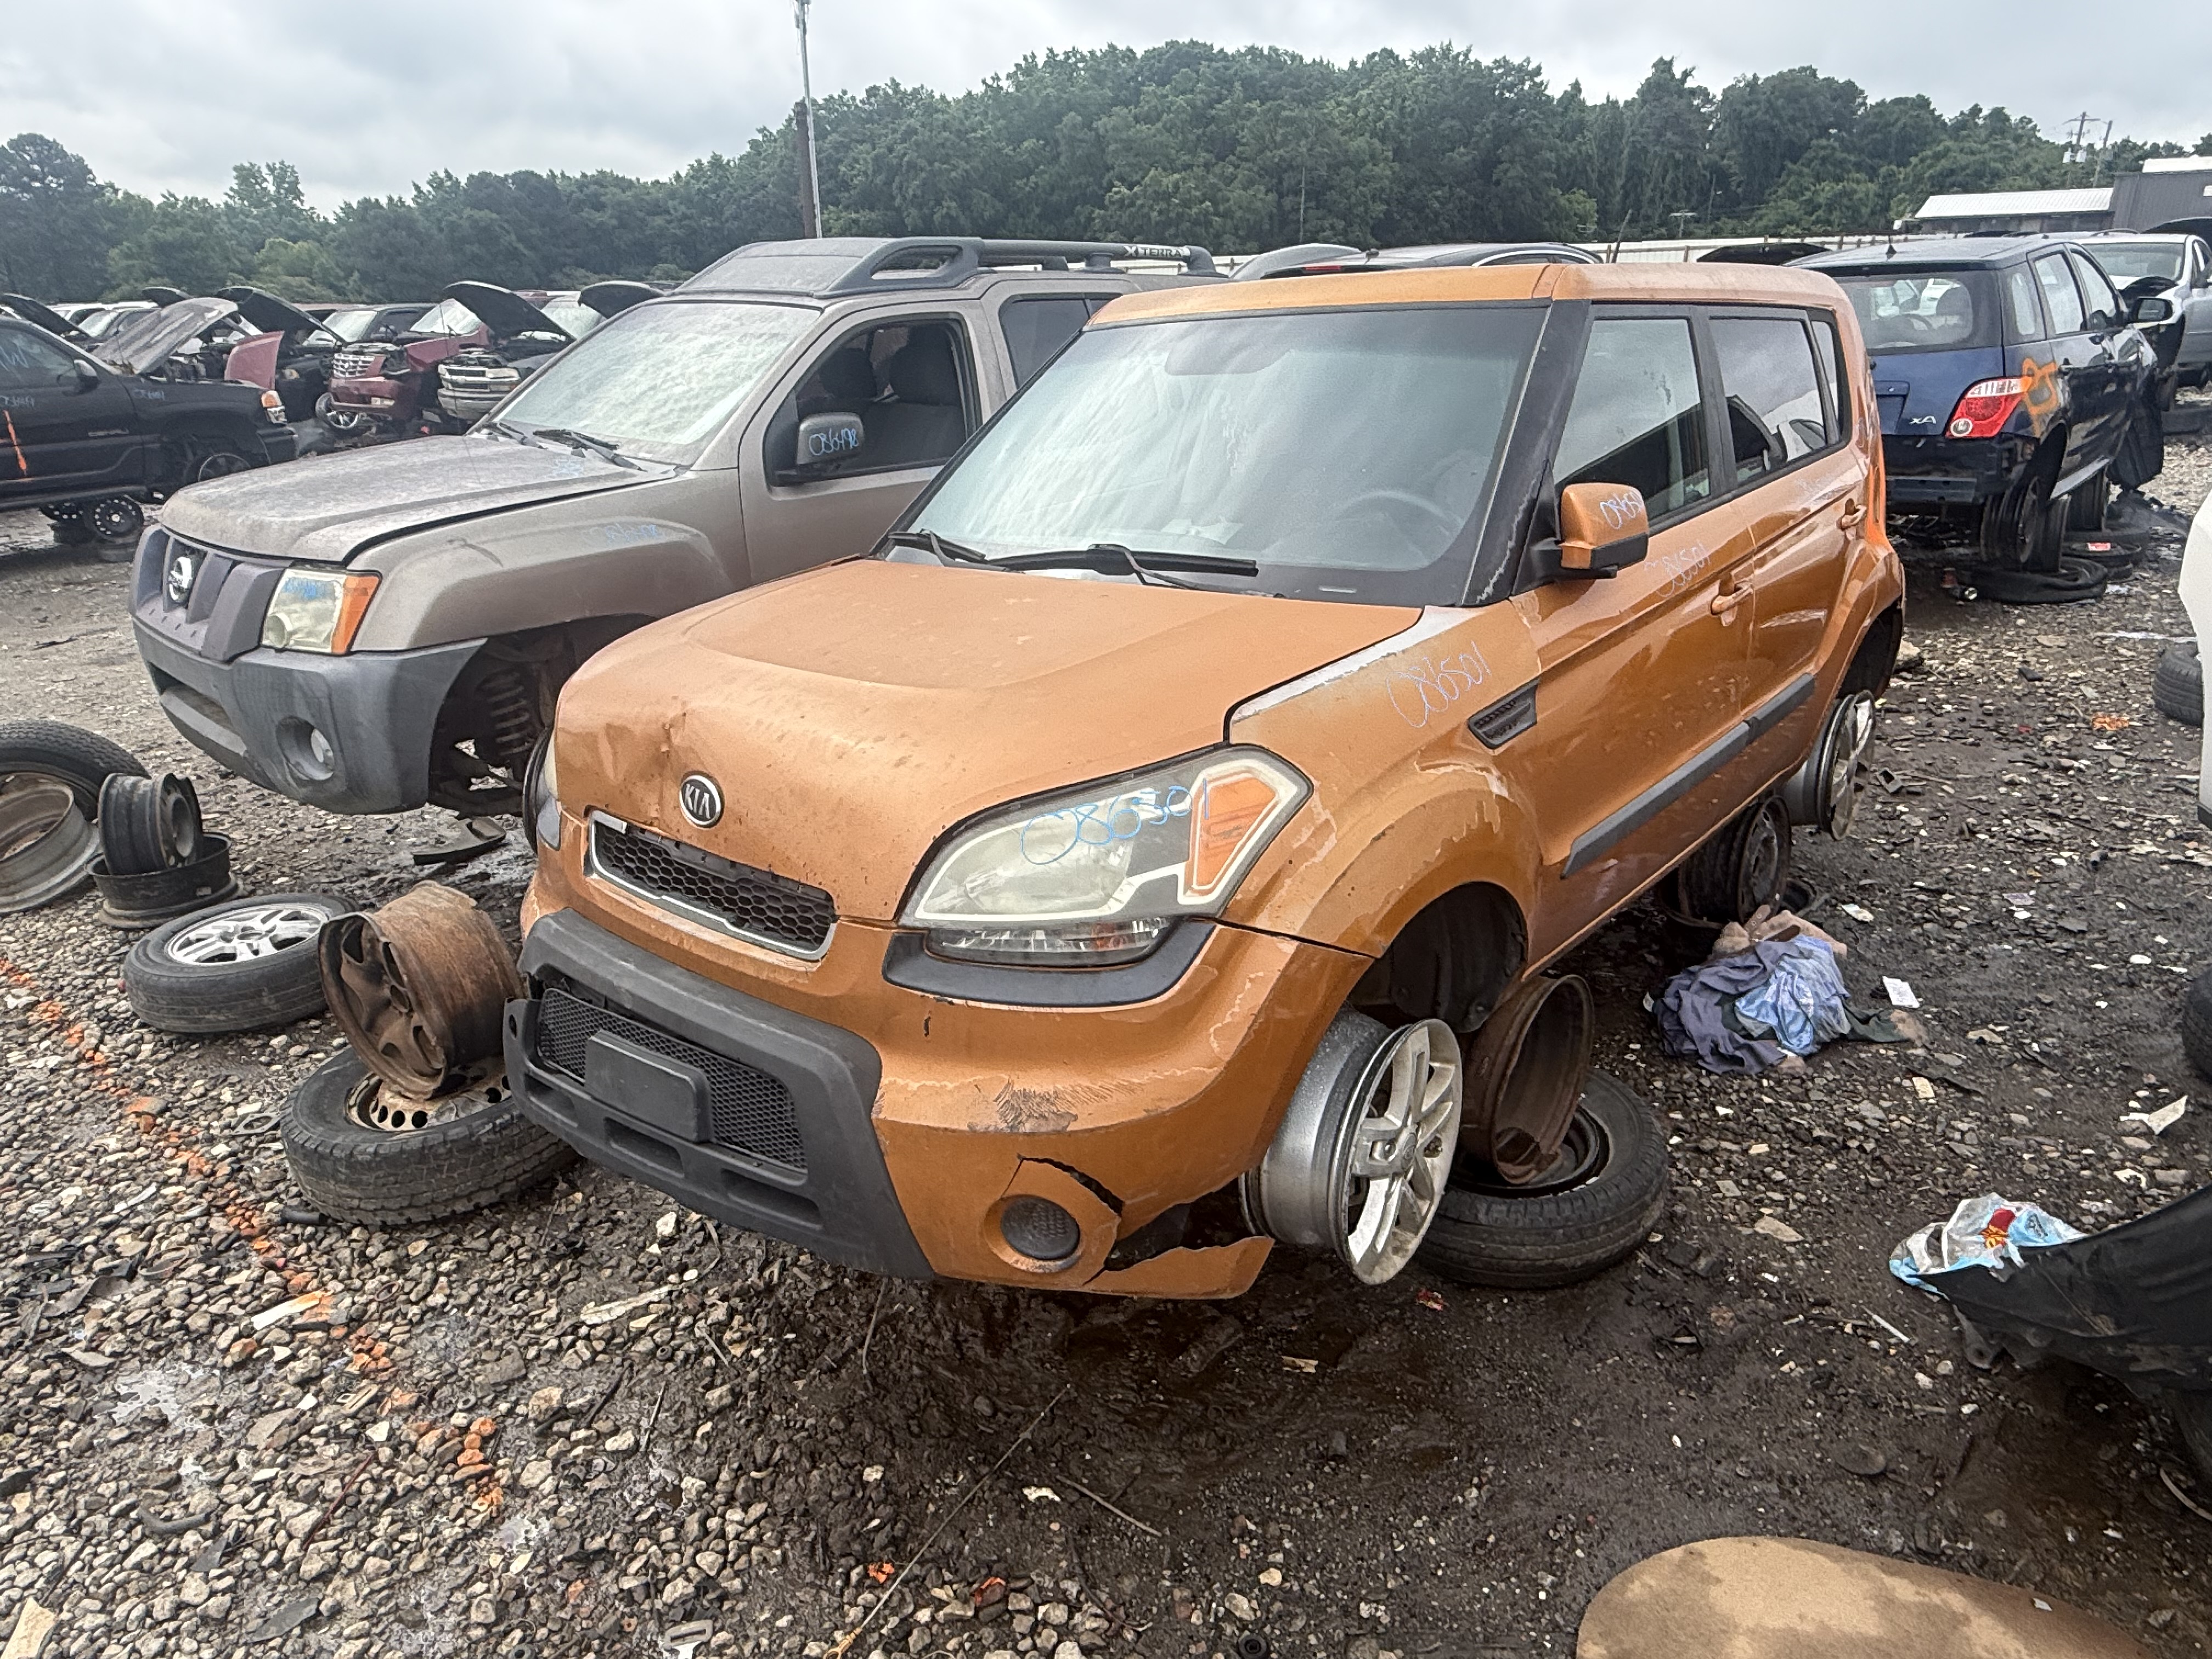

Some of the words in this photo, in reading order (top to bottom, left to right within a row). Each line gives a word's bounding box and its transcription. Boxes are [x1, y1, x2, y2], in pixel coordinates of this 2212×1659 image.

[1124, 245, 1183, 257] XTERRA
[1386, 640, 1492, 729] 086501
[685, 783, 711, 819] KIA
[1020, 778, 1209, 866] 086501
